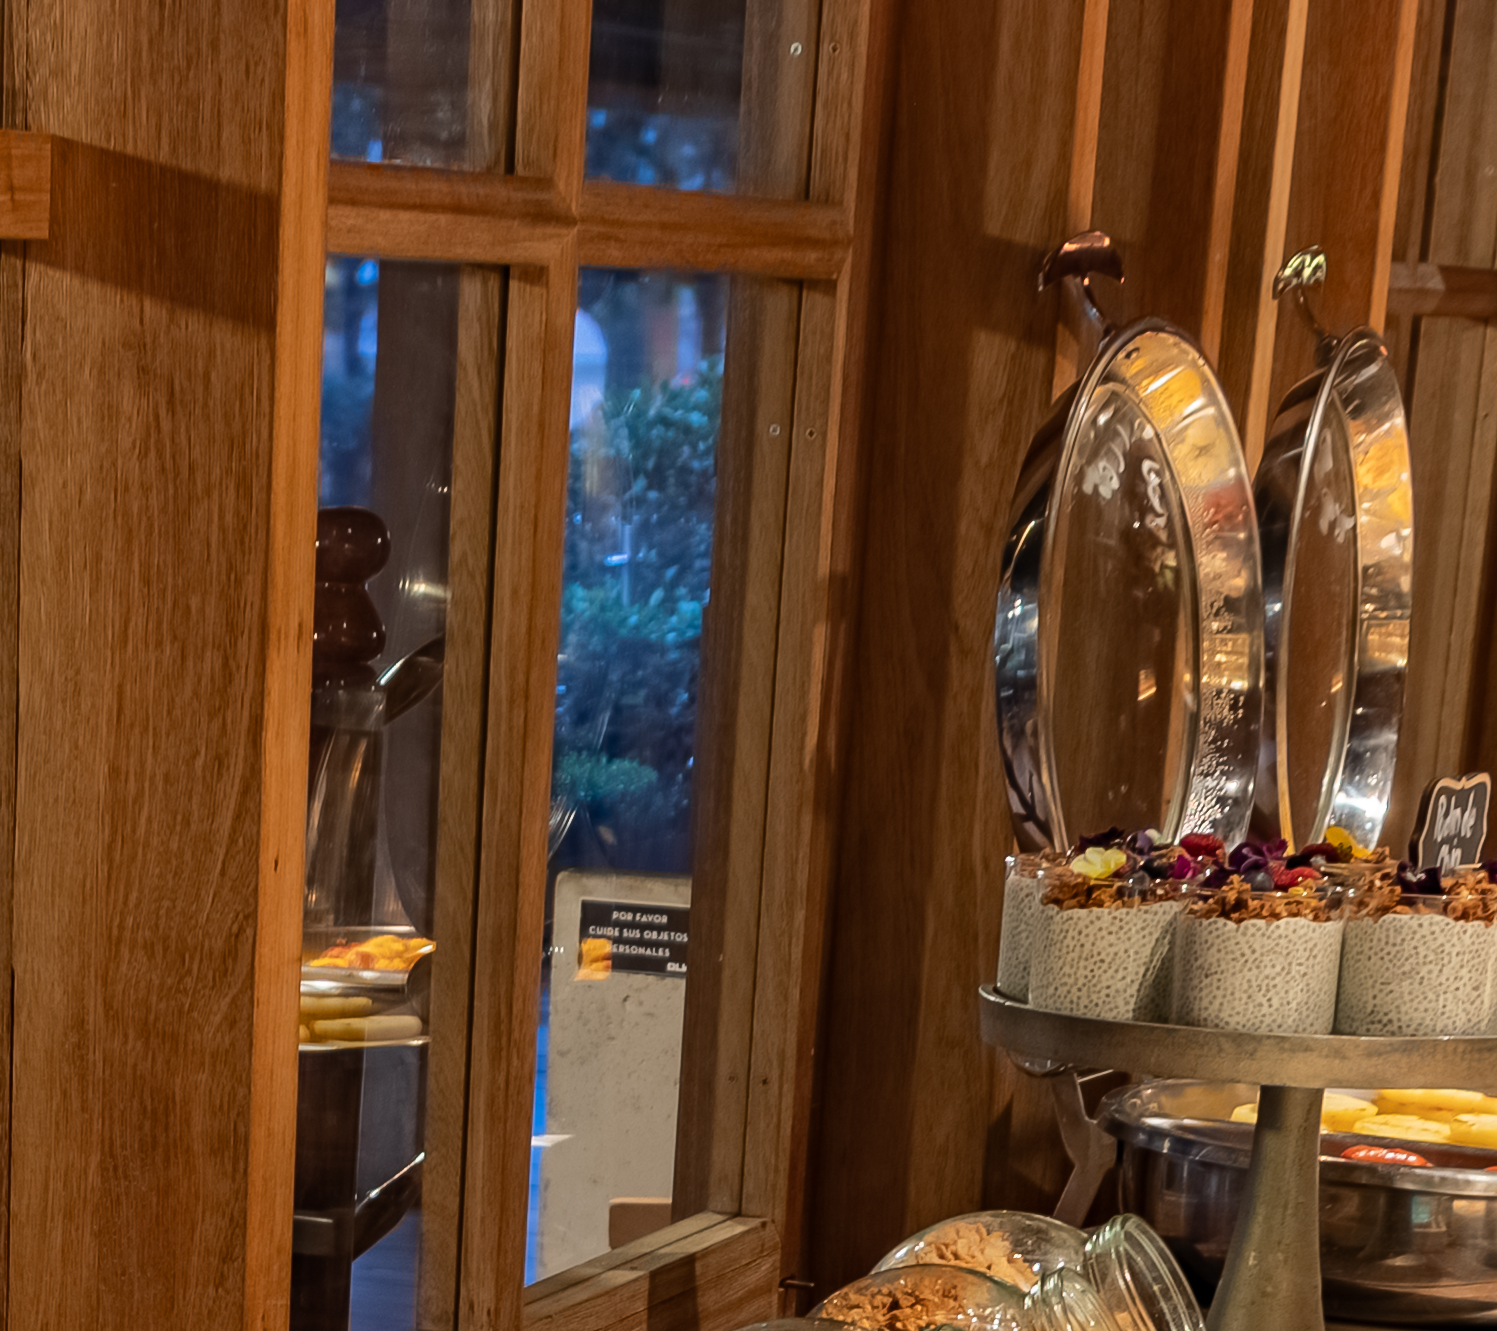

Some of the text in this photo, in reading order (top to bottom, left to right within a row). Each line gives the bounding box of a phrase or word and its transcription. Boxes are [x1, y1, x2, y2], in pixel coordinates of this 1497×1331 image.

[612, 911, 668, 923] POR FAVOR
[588, 925, 689, 942] CUIDE SUS OBJETOS
